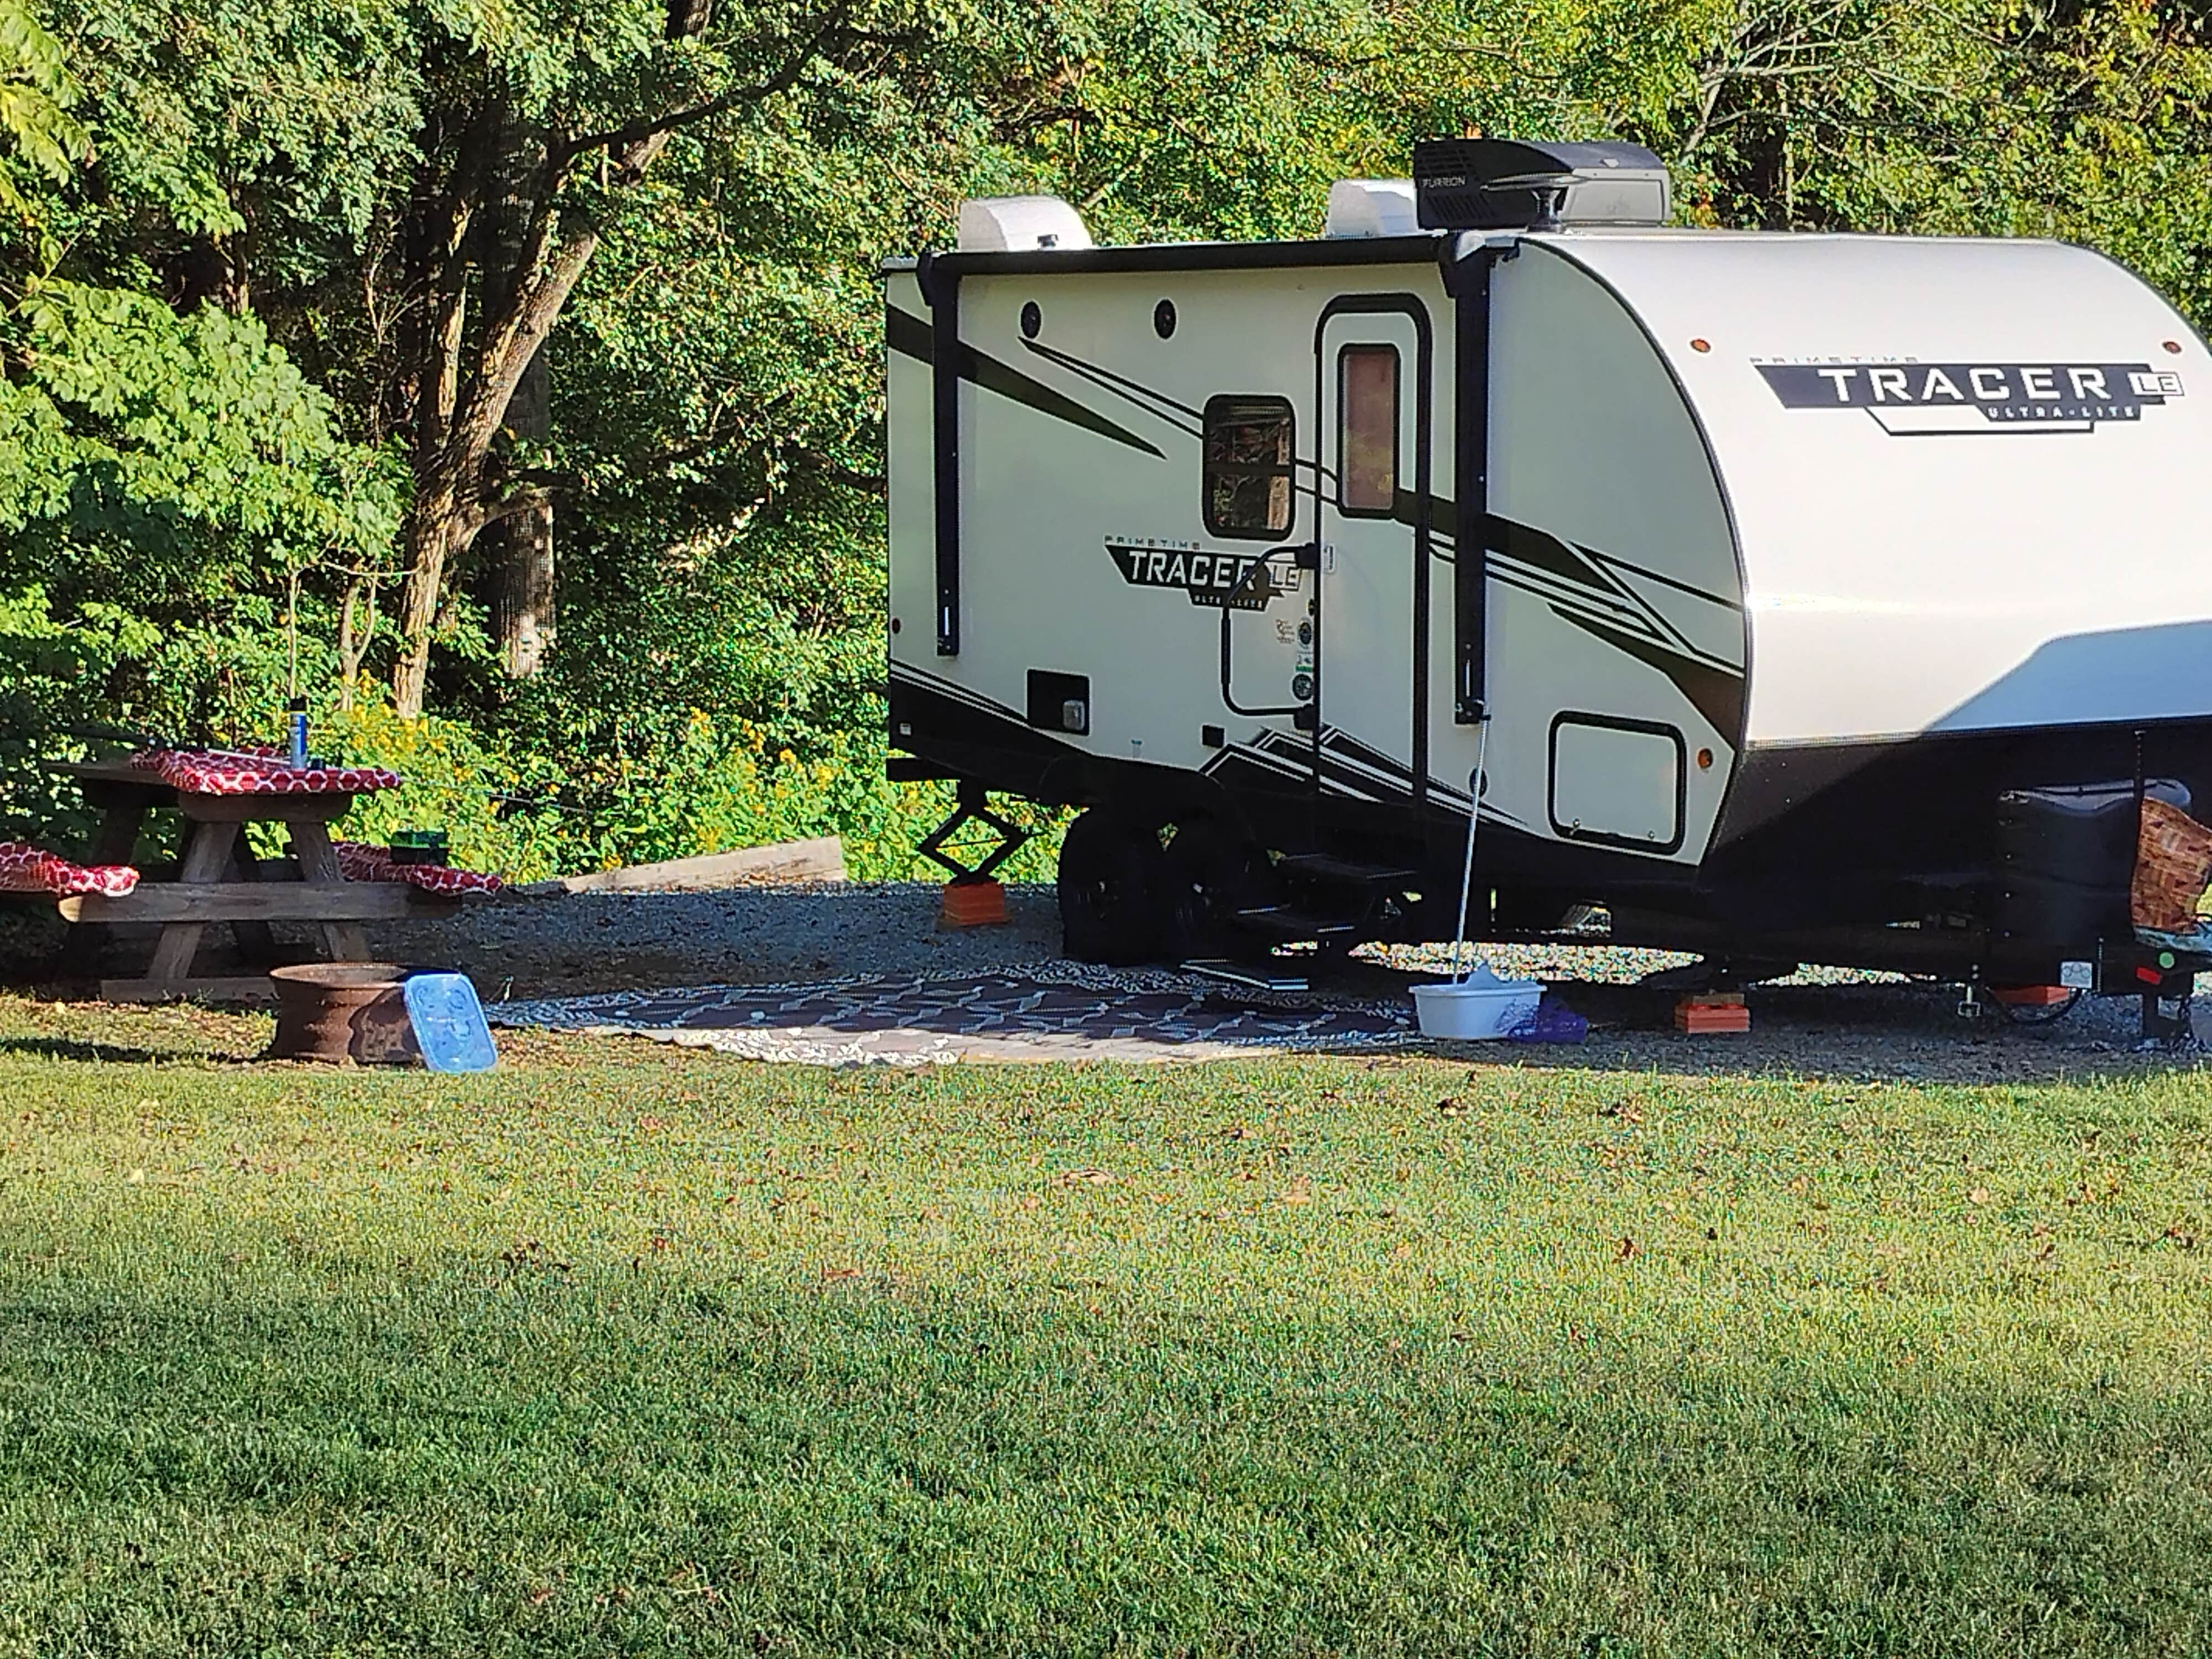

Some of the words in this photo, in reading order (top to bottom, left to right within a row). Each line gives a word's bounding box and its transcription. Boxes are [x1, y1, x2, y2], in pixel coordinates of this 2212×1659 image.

[1817, 368, 2112, 402] TRACER
[2136, 374, 2180, 393] LE
[1987, 405, 2135, 419] ULTRA-LITE
[1129, 551, 1256, 591] TRACER
